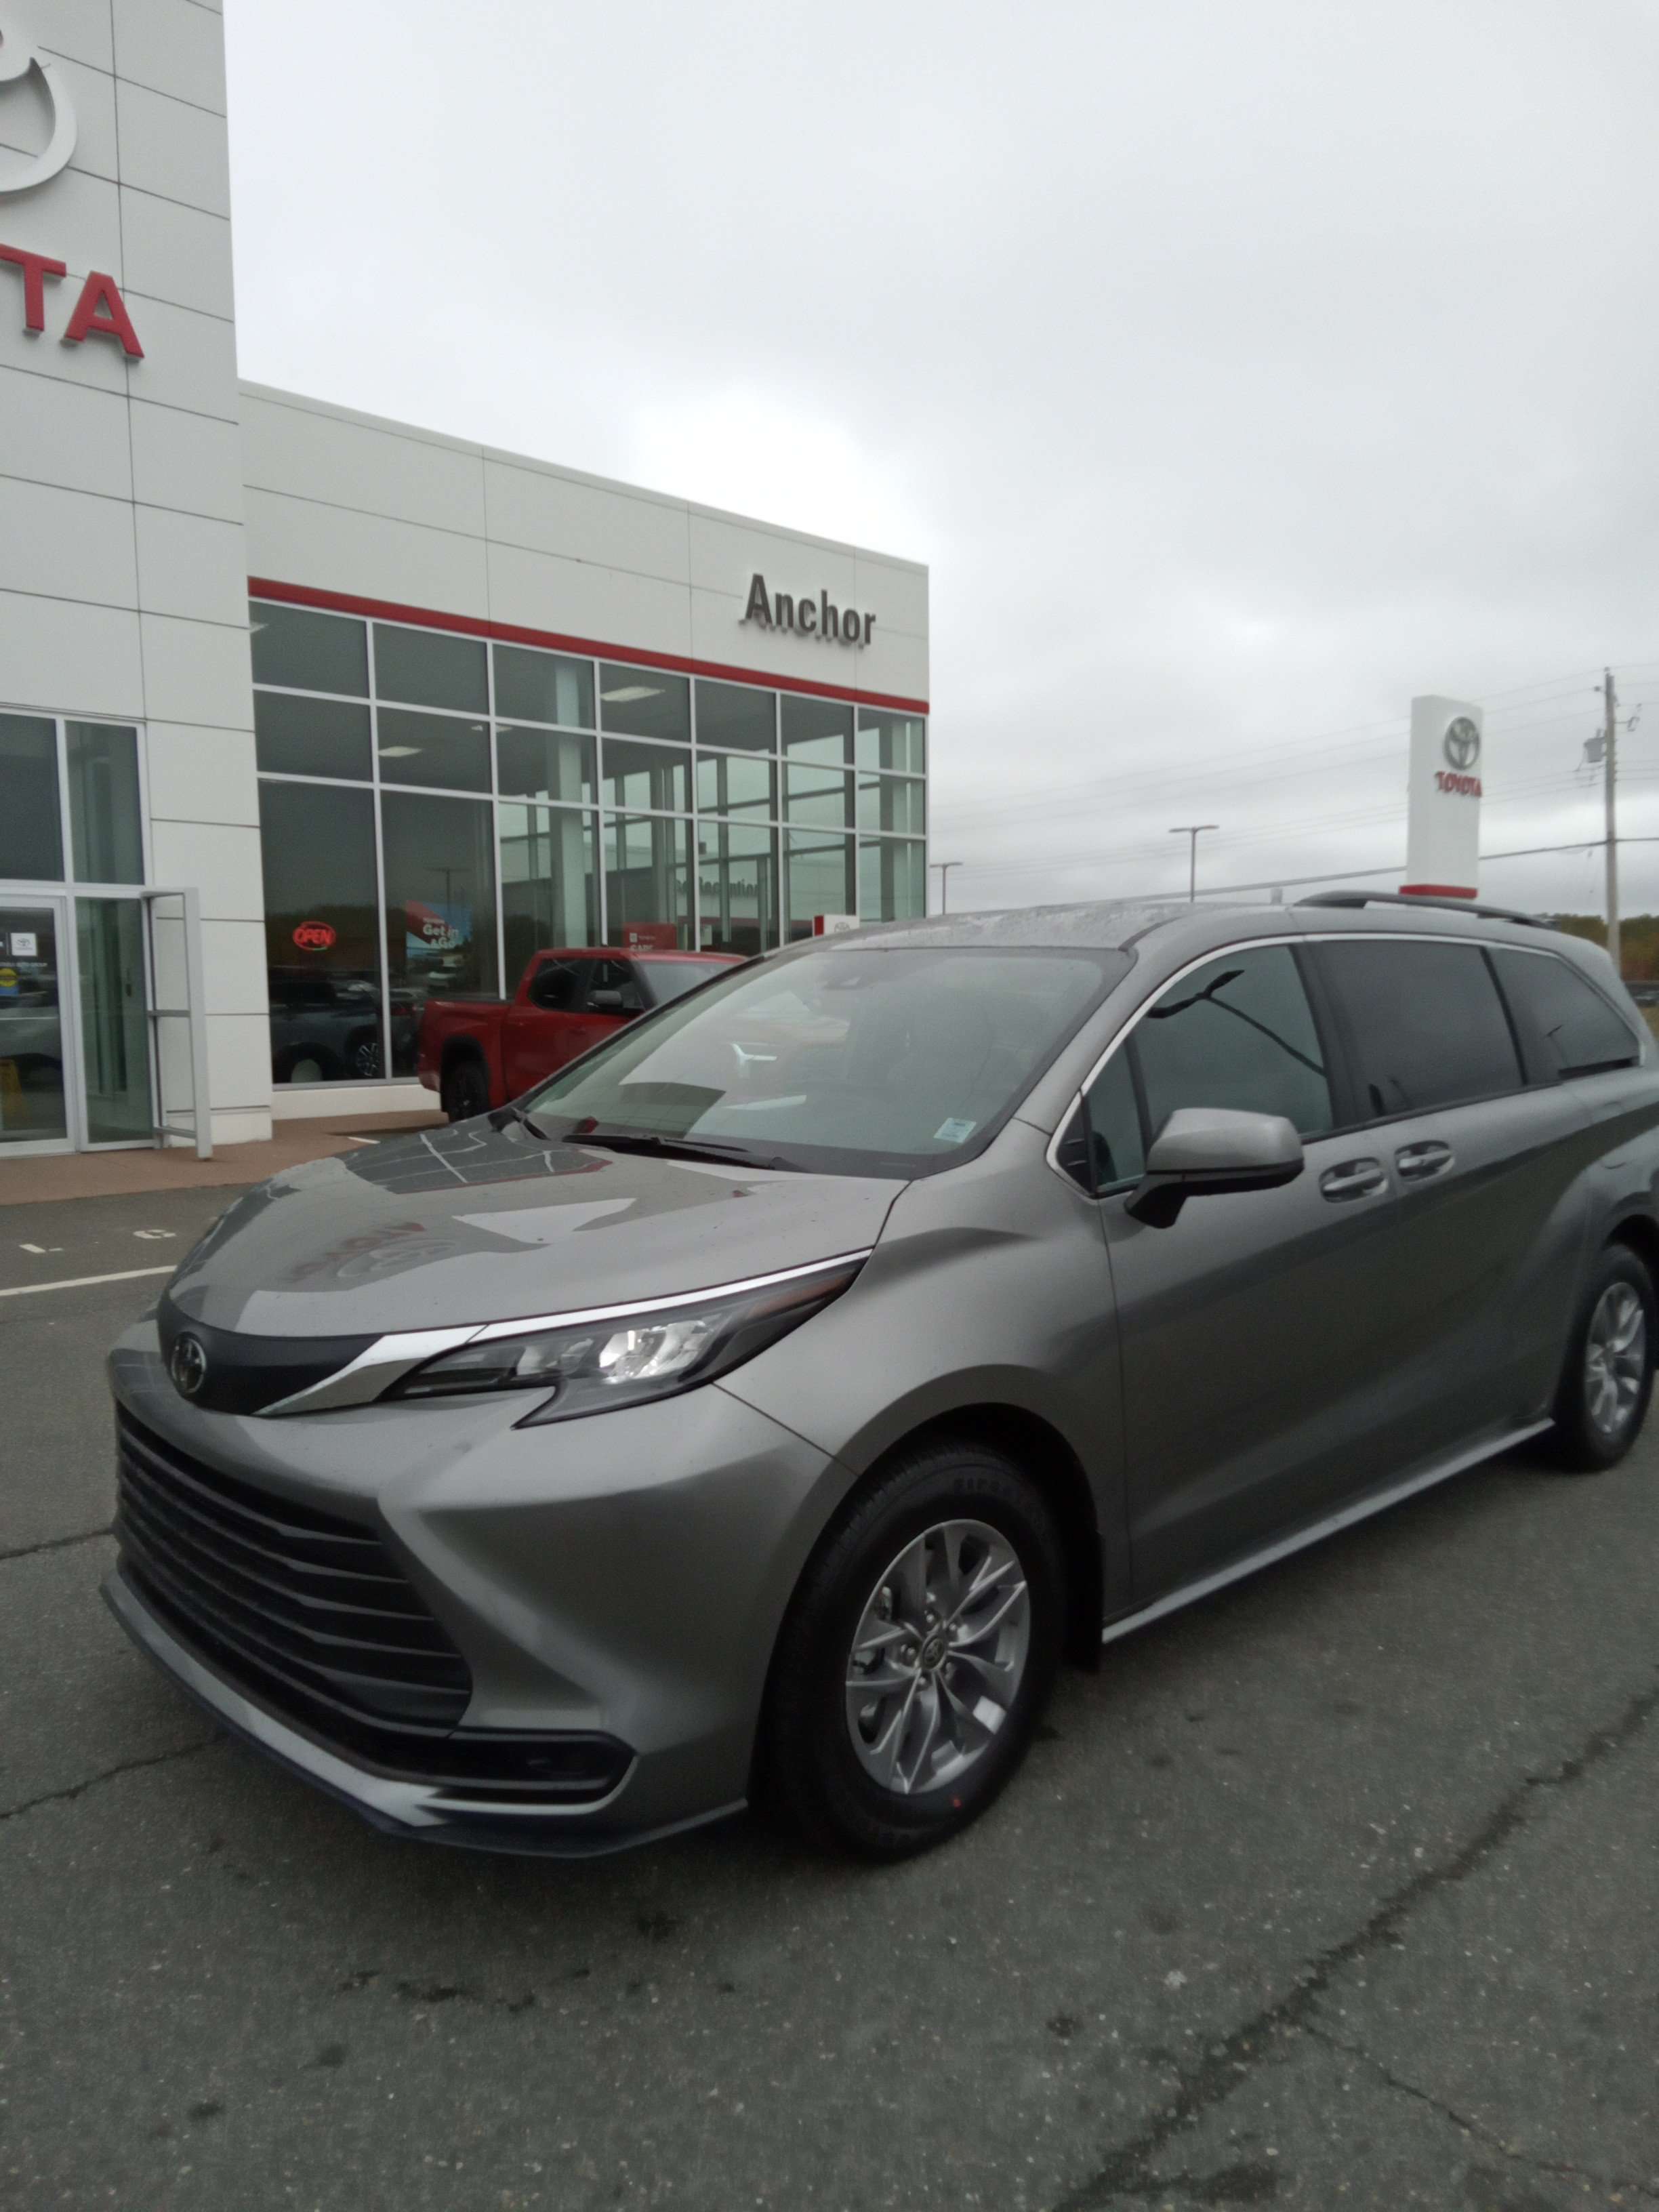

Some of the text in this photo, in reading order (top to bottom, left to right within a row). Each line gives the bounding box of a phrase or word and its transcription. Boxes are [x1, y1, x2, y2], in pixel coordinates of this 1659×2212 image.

[745, 573, 876, 644] Anchor
[1435, 771, 1483, 798] TOYOTA
[294, 928, 331, 946] OPEN
[423, 923, 445, 937] Get
